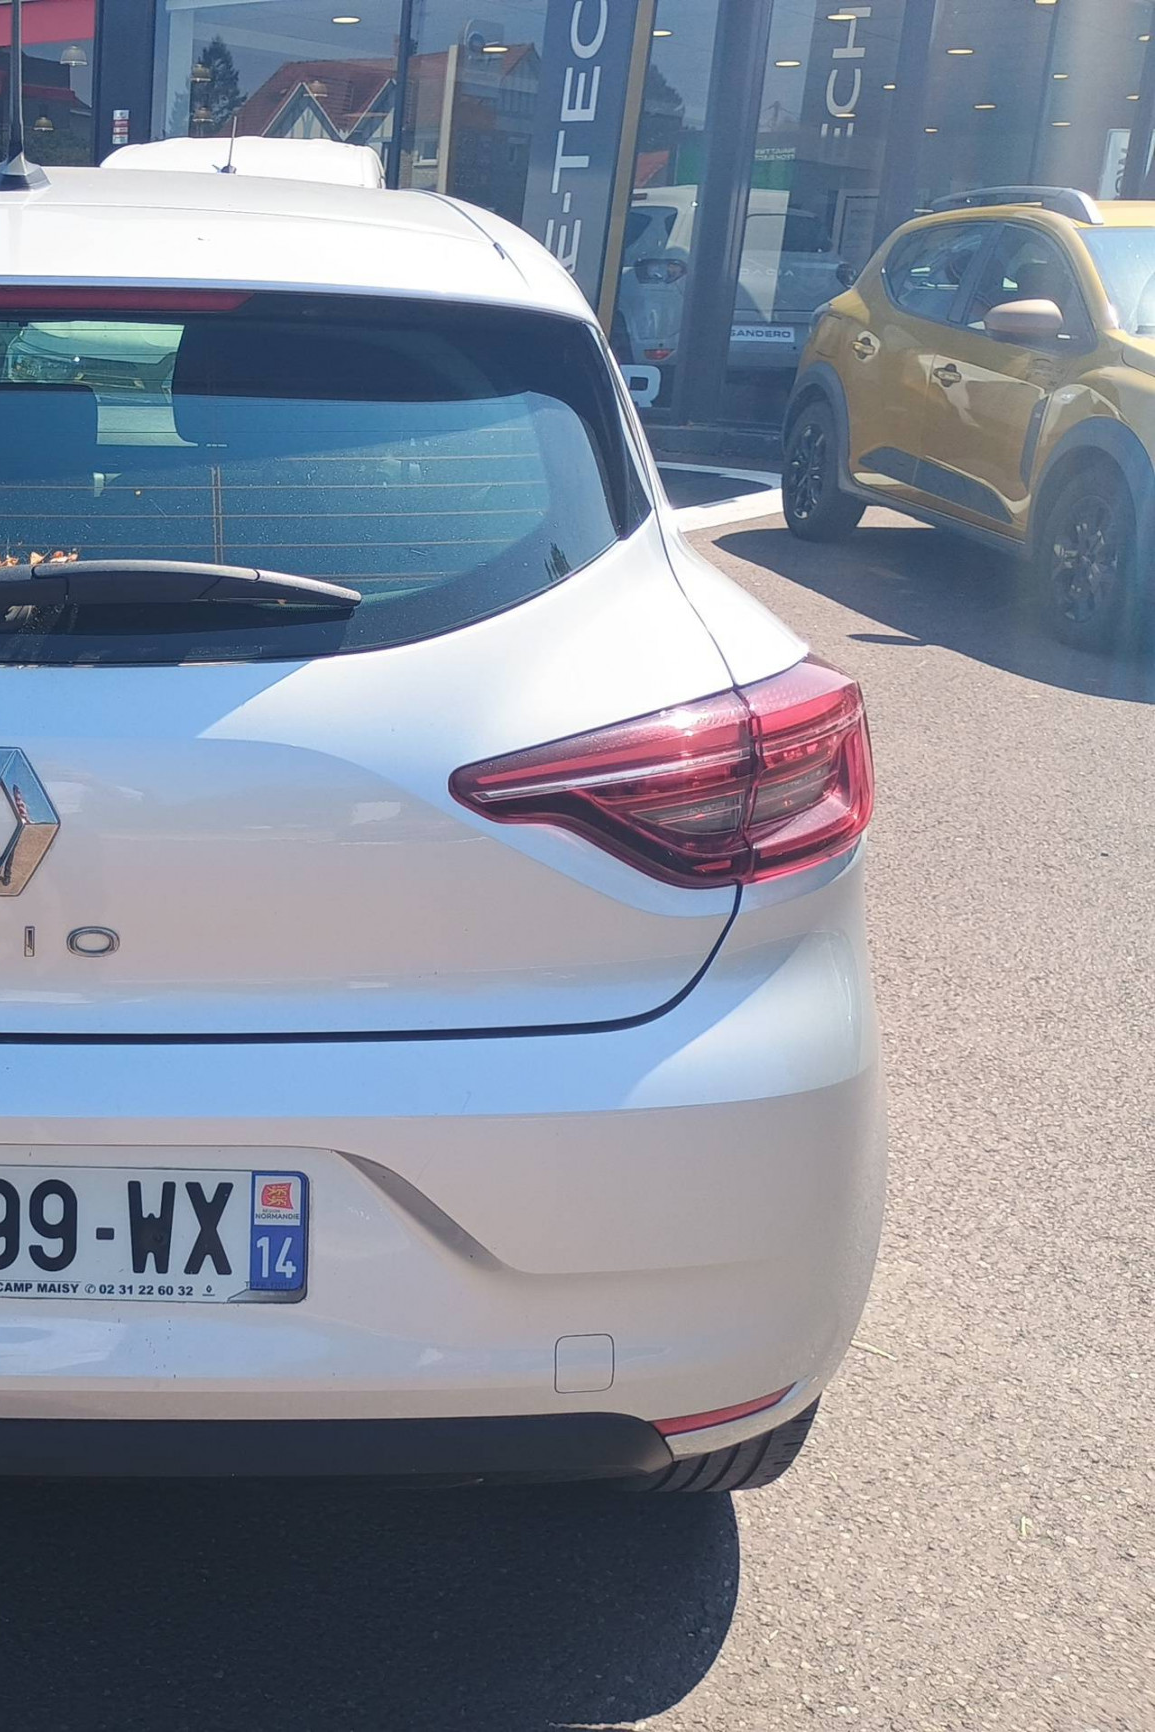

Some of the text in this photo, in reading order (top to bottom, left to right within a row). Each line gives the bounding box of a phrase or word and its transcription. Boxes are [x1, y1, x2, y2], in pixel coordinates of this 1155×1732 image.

[730, 329, 791, 338] SANDERO
[255, 1212, 301, 1221] NORMANDIE
[256, 1236, 297, 1279] 14
[36, 1282, 80, 1294] MAISY
[98, 1284, 115, 1295] 02
[119, 1284, 134, 1295] 31
[138, 1285, 154, 1296] 22
[158, 1285, 174, 1296] 60
[178, 1286, 193, 1296] 32
